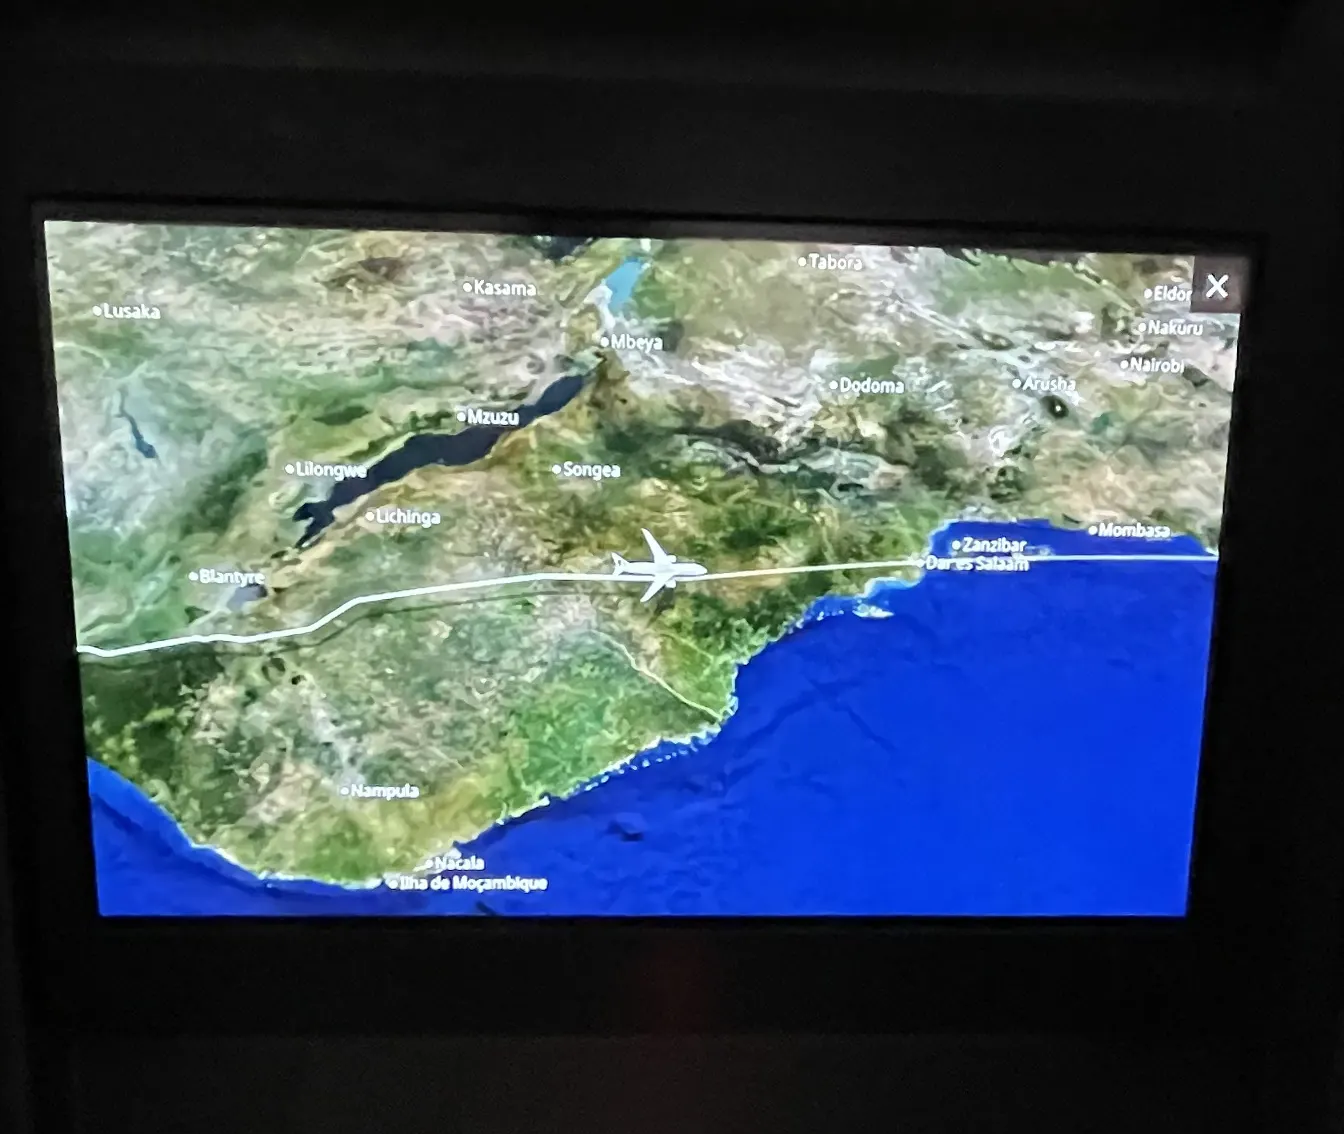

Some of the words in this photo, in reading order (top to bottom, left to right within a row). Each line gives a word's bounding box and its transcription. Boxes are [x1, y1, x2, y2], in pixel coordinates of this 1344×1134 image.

[809, 253, 863, 271] Tabora
[474, 279, 537, 297] Kasama
[104, 304, 161, 319] Lusaka
[1148, 319, 1203, 336] Nakuru
[611, 333, 663, 351] Mbeya
[1130, 357, 1185, 374] Nairobi
[840, 376, 905, 394] Dodoma
[1022, 375, 1076, 391] Arusha
[468, 409, 519, 426] Mzuzu
[296, 461, 367, 480] Lilongwe
[563, 461, 621, 480] Songea
[1098, 522, 1170, 538] Mombasa
[962, 536, 1027, 553] Zanzibar
[975, 555, 1029, 572] Salaam
[199, 568, 265, 587] Blantyre
[351, 784, 420, 801] Nampula
[435, 856, 485, 871] Nacala
[431, 876, 450, 890] de
[453, 875, 548, 893] Moçambique
